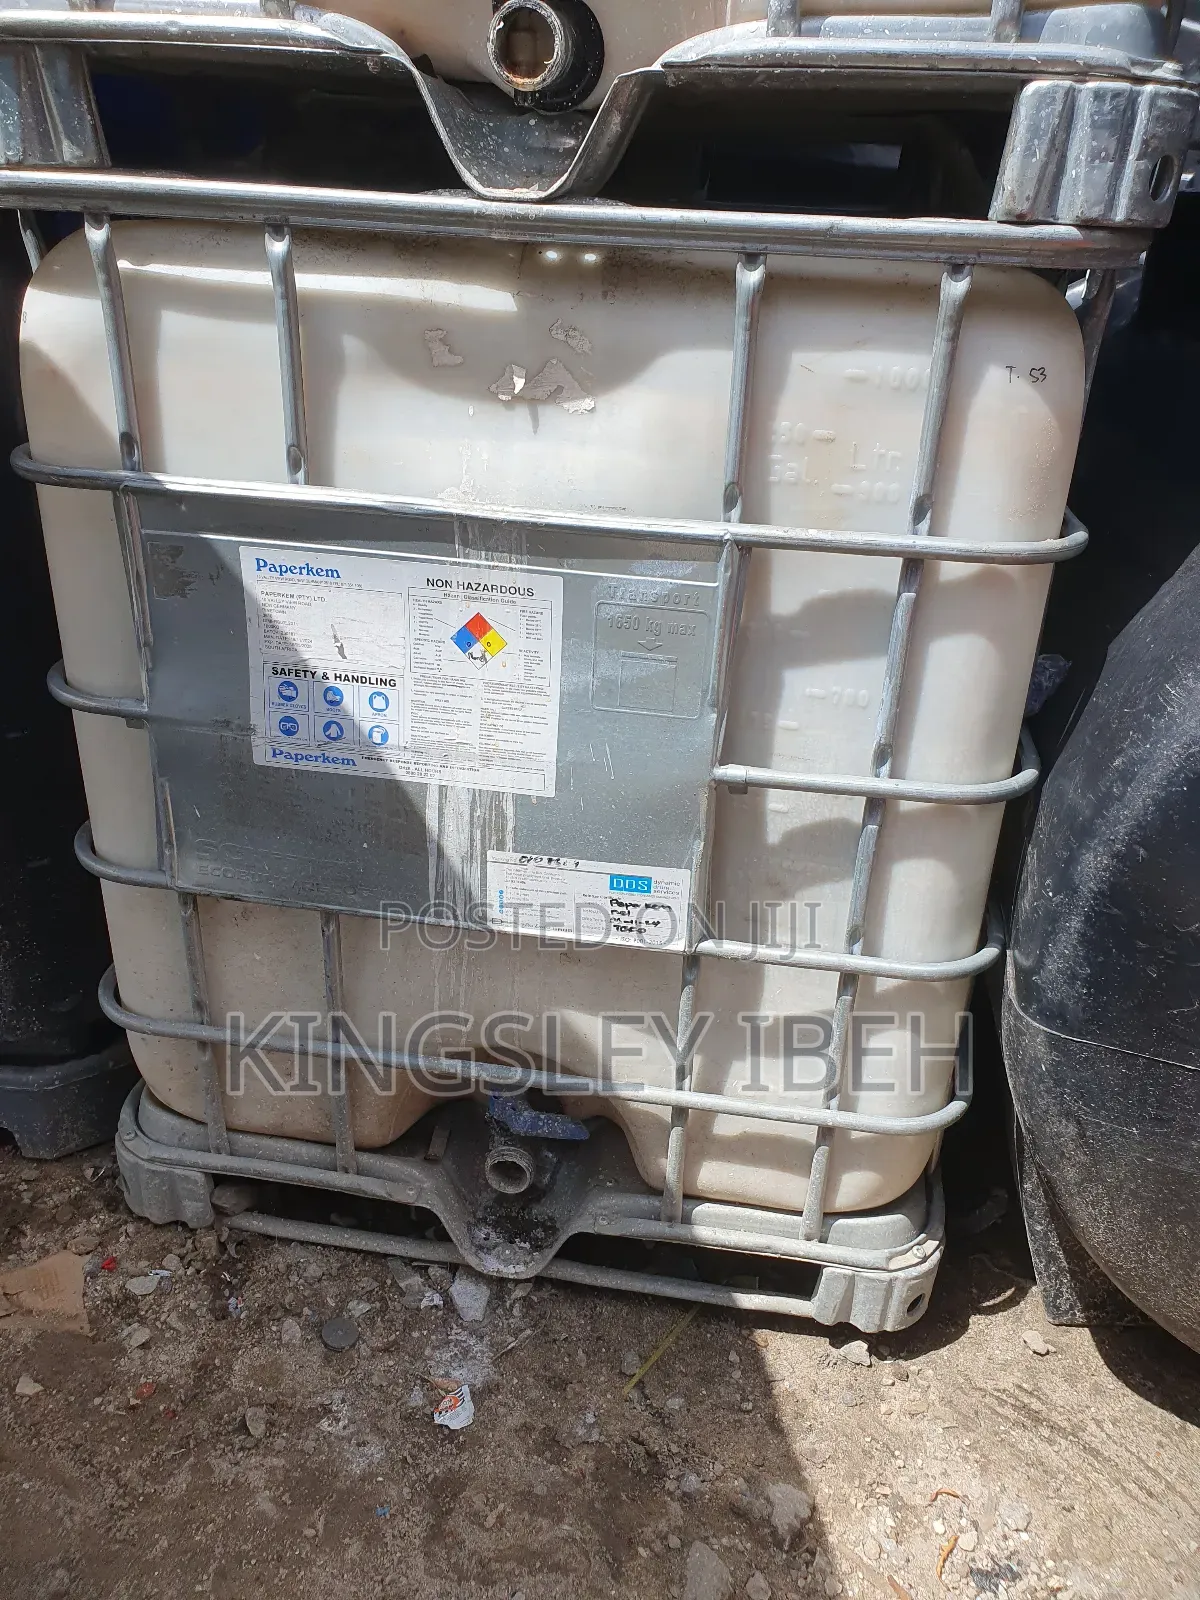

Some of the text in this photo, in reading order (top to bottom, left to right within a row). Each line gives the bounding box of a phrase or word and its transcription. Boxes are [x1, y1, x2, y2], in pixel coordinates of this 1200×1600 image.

[255, 557, 341, 579] Paperkem
[260, 590, 295, 600] PAPERKEM
[426, 577, 534, 597] NON HAZARDOUS
[608, 583, 700, 607] Transport
[606, 613, 697, 637] 1650 kg max
[271, 666, 318, 680] SAFETY
[321, 671, 330, 681] &
[334, 672, 397, 688] HANDLING
[271, 747, 357, 767] Paperkem
